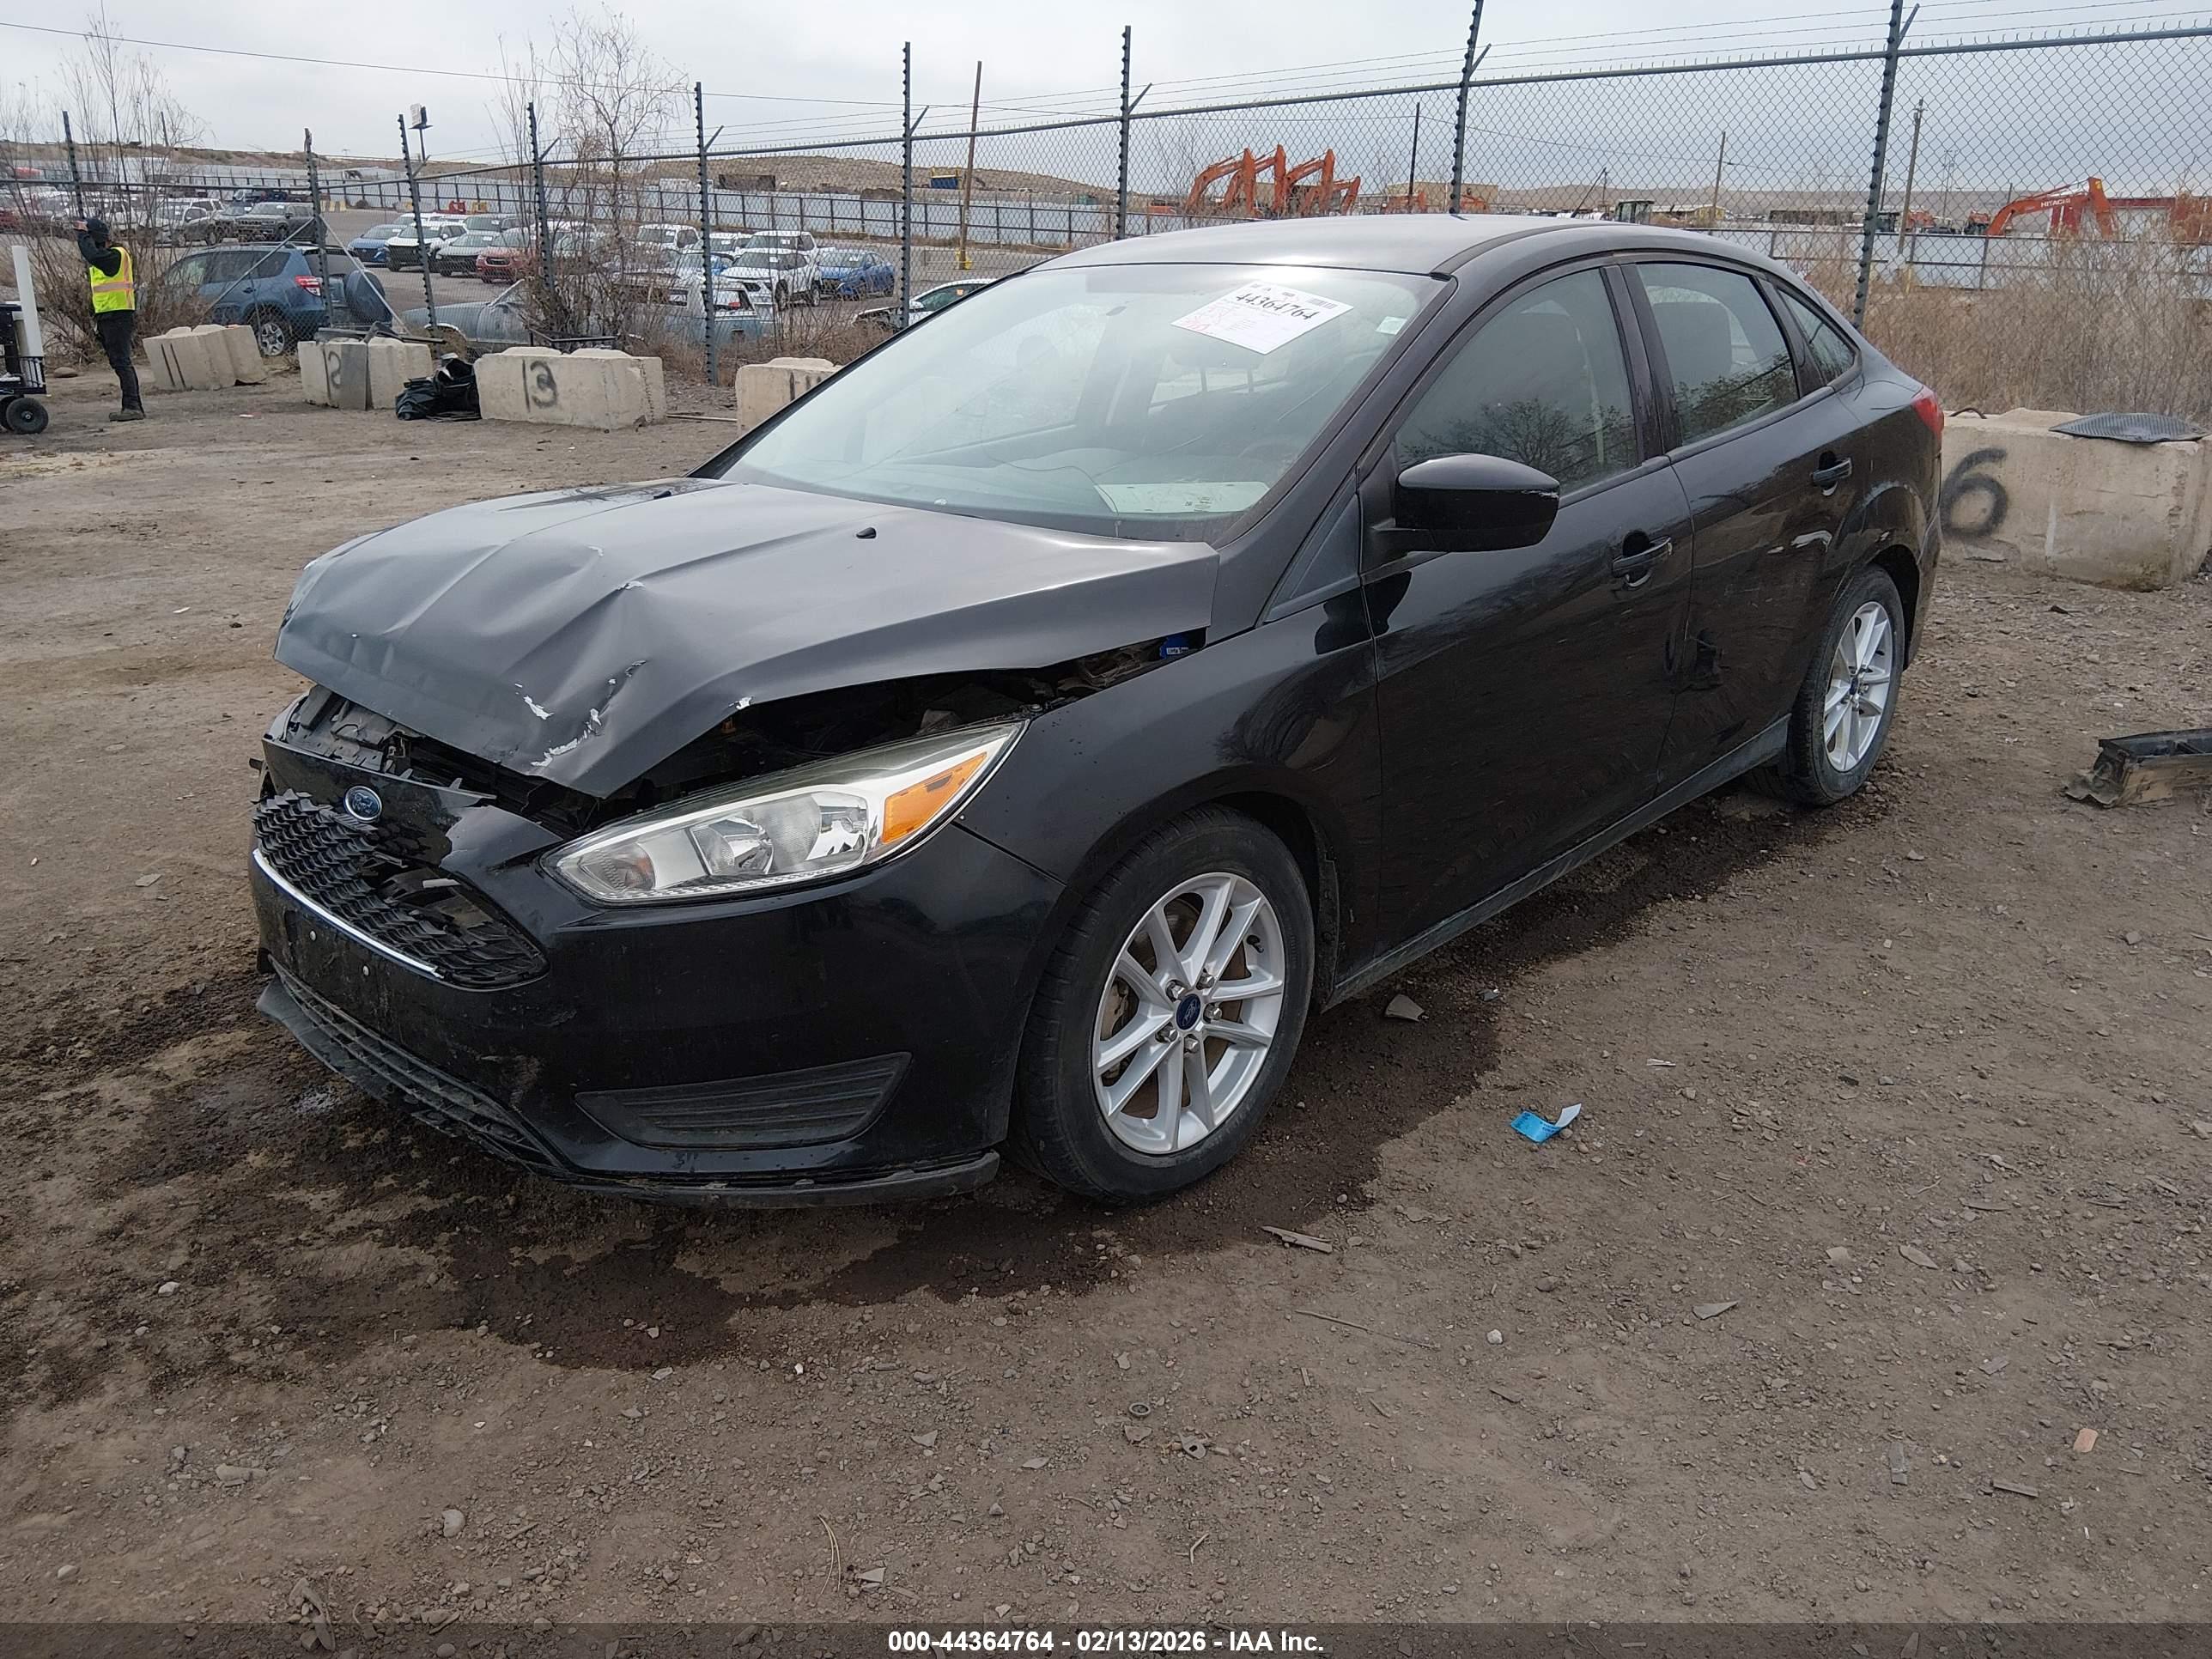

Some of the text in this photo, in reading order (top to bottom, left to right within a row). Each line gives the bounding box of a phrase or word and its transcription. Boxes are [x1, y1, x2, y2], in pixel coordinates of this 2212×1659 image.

[2040, 198, 2071, 208] HITACHI
[1236, 293, 1320, 320] 44364764
[522, 359, 558, 413] 13
[1940, 447, 2008, 541] 6
